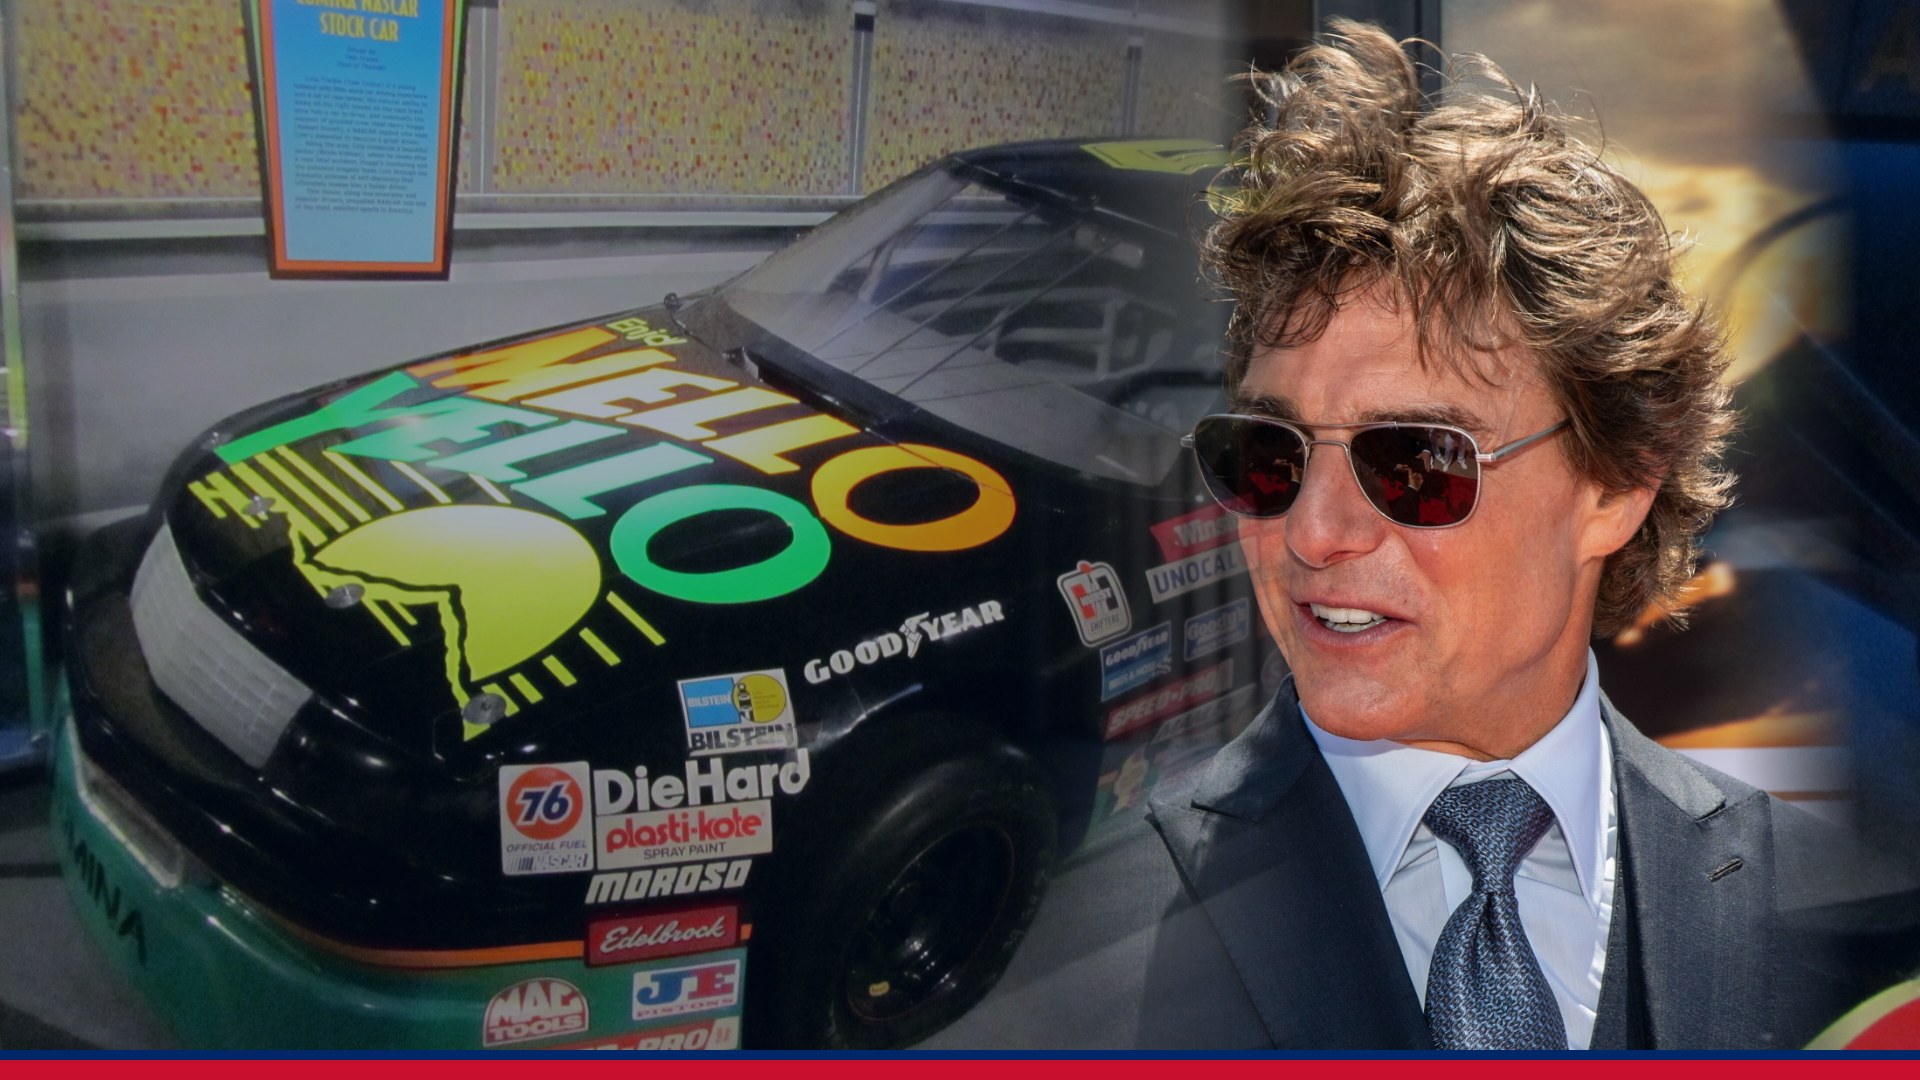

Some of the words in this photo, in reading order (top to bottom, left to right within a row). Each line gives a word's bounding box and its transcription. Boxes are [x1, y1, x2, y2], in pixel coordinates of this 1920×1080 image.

[319, 12, 365, 38] STOCK
[369, 18, 399, 42] CAR
[405, 325, 1017, 552] MELLO
[213, 370, 832, 604] YELLO
[1153, 550, 1238, 595] UNOCAL
[803, 600, 1005, 685] GOODYEAR
[1105, 631, 1168, 667] GOODYEAR
[687, 692, 732, 708] BILSTEIN
[516, 780, 572, 826] 76
[593, 747, 811, 816] DieHard
[506, 842, 557, 853] OFFICIAL
[559, 839, 588, 850] FUEL
[605, 807, 763, 853] plasti-kote
[643, 846, 686, 861] SPRAY
[688, 841, 727, 856] PAINT
[584, 858, 753, 905] MOROSO
[600, 915, 726, 954] Edelbrock
[489, 981, 583, 1028] MAC
[635, 962, 737, 1006] JE
[488, 1014, 583, 1041] TOOLS
[636, 998, 734, 1018] PISTONS
